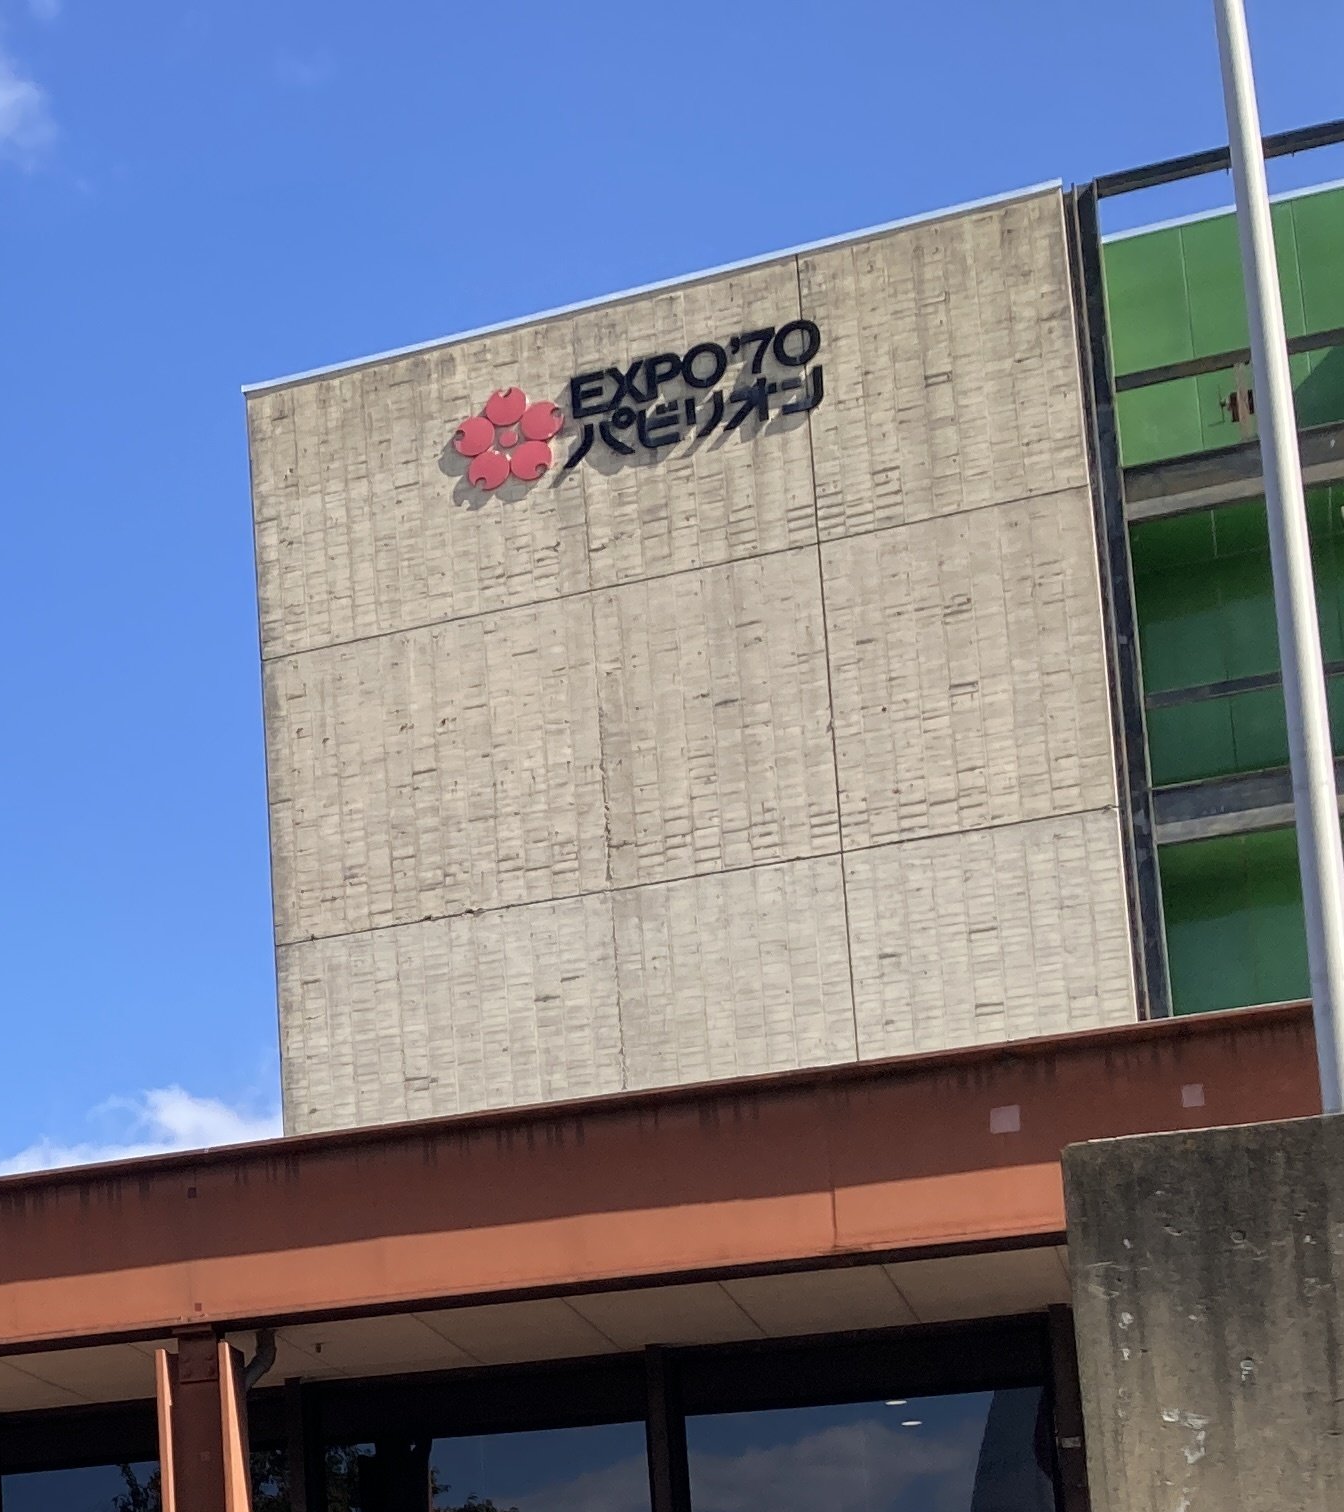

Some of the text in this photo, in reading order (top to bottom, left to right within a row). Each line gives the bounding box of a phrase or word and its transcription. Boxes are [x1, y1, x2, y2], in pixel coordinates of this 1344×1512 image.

[564, 365, 824, 469] パビリオン
[569, 319, 822, 419] EXPO'70
